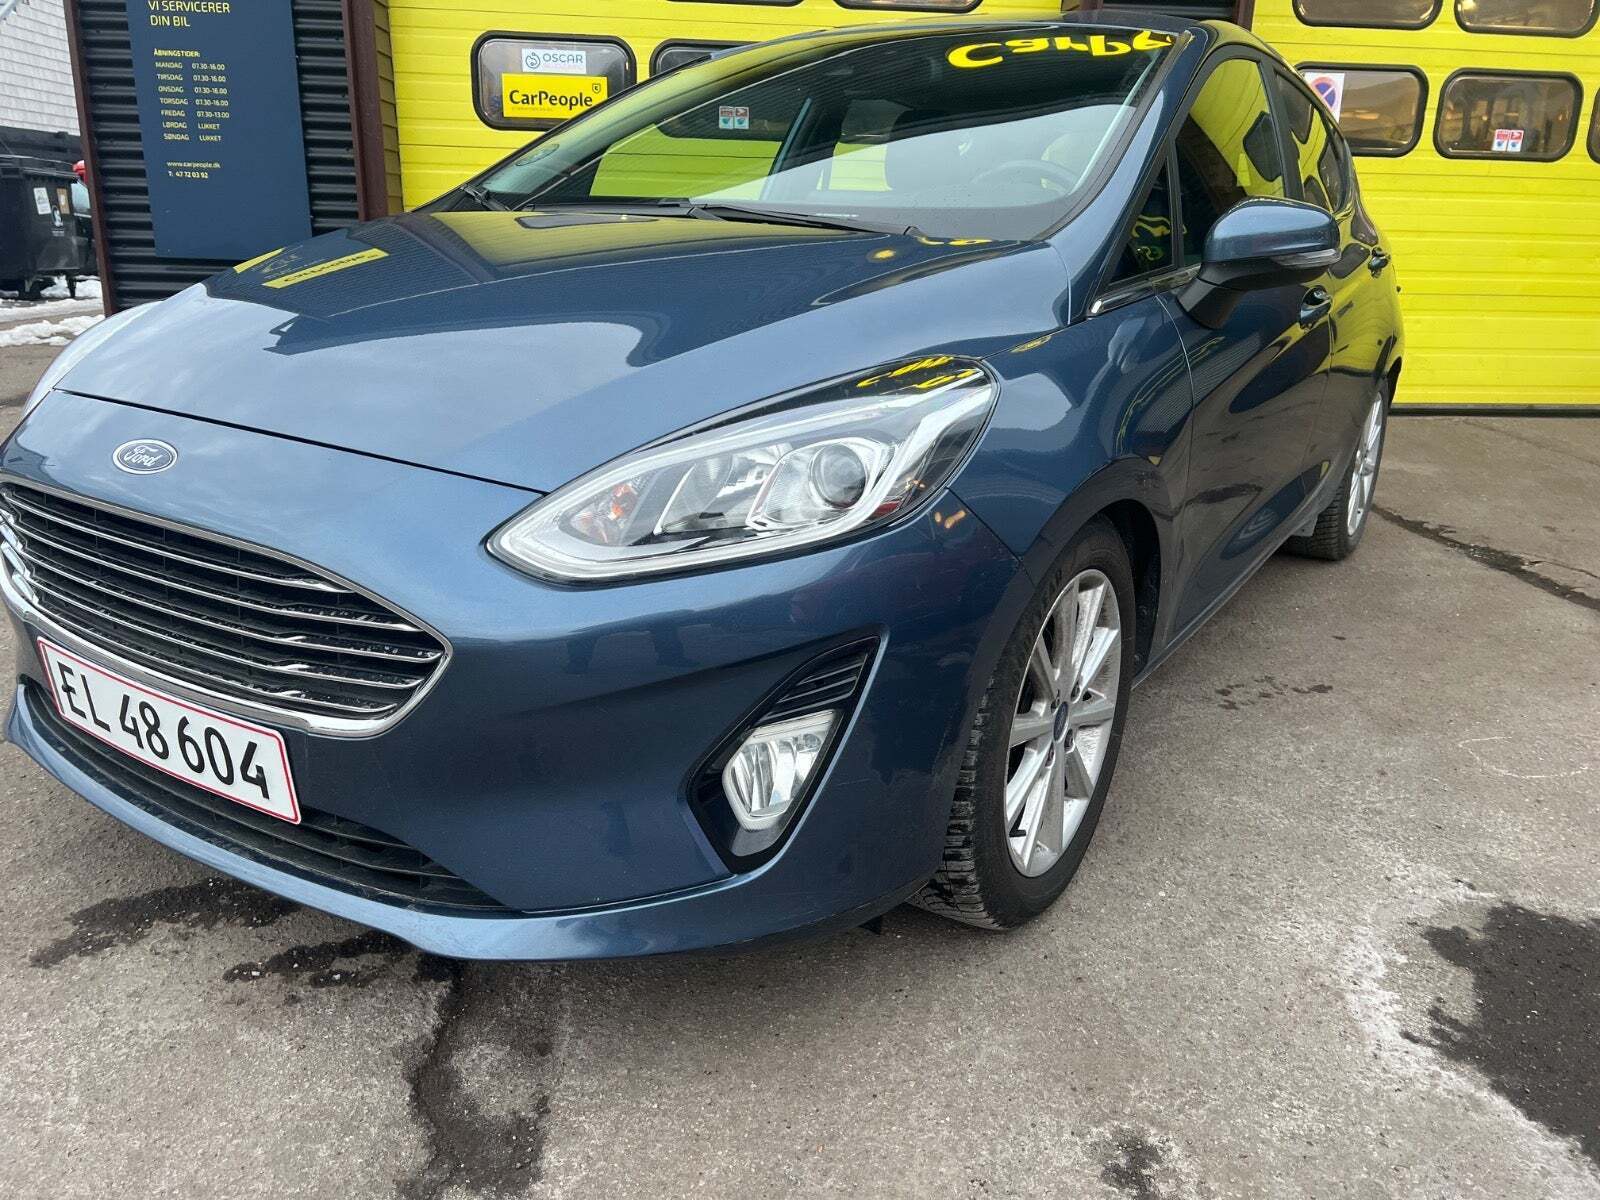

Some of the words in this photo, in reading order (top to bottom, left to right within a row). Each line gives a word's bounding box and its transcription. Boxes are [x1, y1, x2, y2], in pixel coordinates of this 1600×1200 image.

[148, 0, 159, 11] VI
[161, 0, 231, 13] SERVICERER
[150, 14, 171, 26] DIN
[172, 15, 191, 27] BIL
[153, 48, 201, 58] ÅBNINGSTIDER:
[542, 52, 584, 64] OSCAR
[155, 61, 183, 69] MANDAG
[191, 62, 226, 71] 07.30-16.00
[156, 73, 184, 81] TIRSDAG
[192, 74, 227, 83] 07.30-16.00
[158, 85, 184, 94] ONSDAG
[194, 86, 228, 95] 07.30-16.00
[160, 97, 189, 105] TORSDAG
[195, 98, 230, 107] 07.30-16.00
[508, 89, 593, 111] CarPeople
[161, 109, 186, 117] FREDAG
[196, 110, 230, 119] 07.30-13.00
[162, 121, 188, 129] LØRDAG
[198, 122, 221, 130] LUKKET
[163, 132, 190, 141] SØNDAG
[123, 444, 164, 467] Ford
[57, 661, 111, 732] EL
[119, 694, 170, 760] 48
[177, 715, 270, 800] 604
